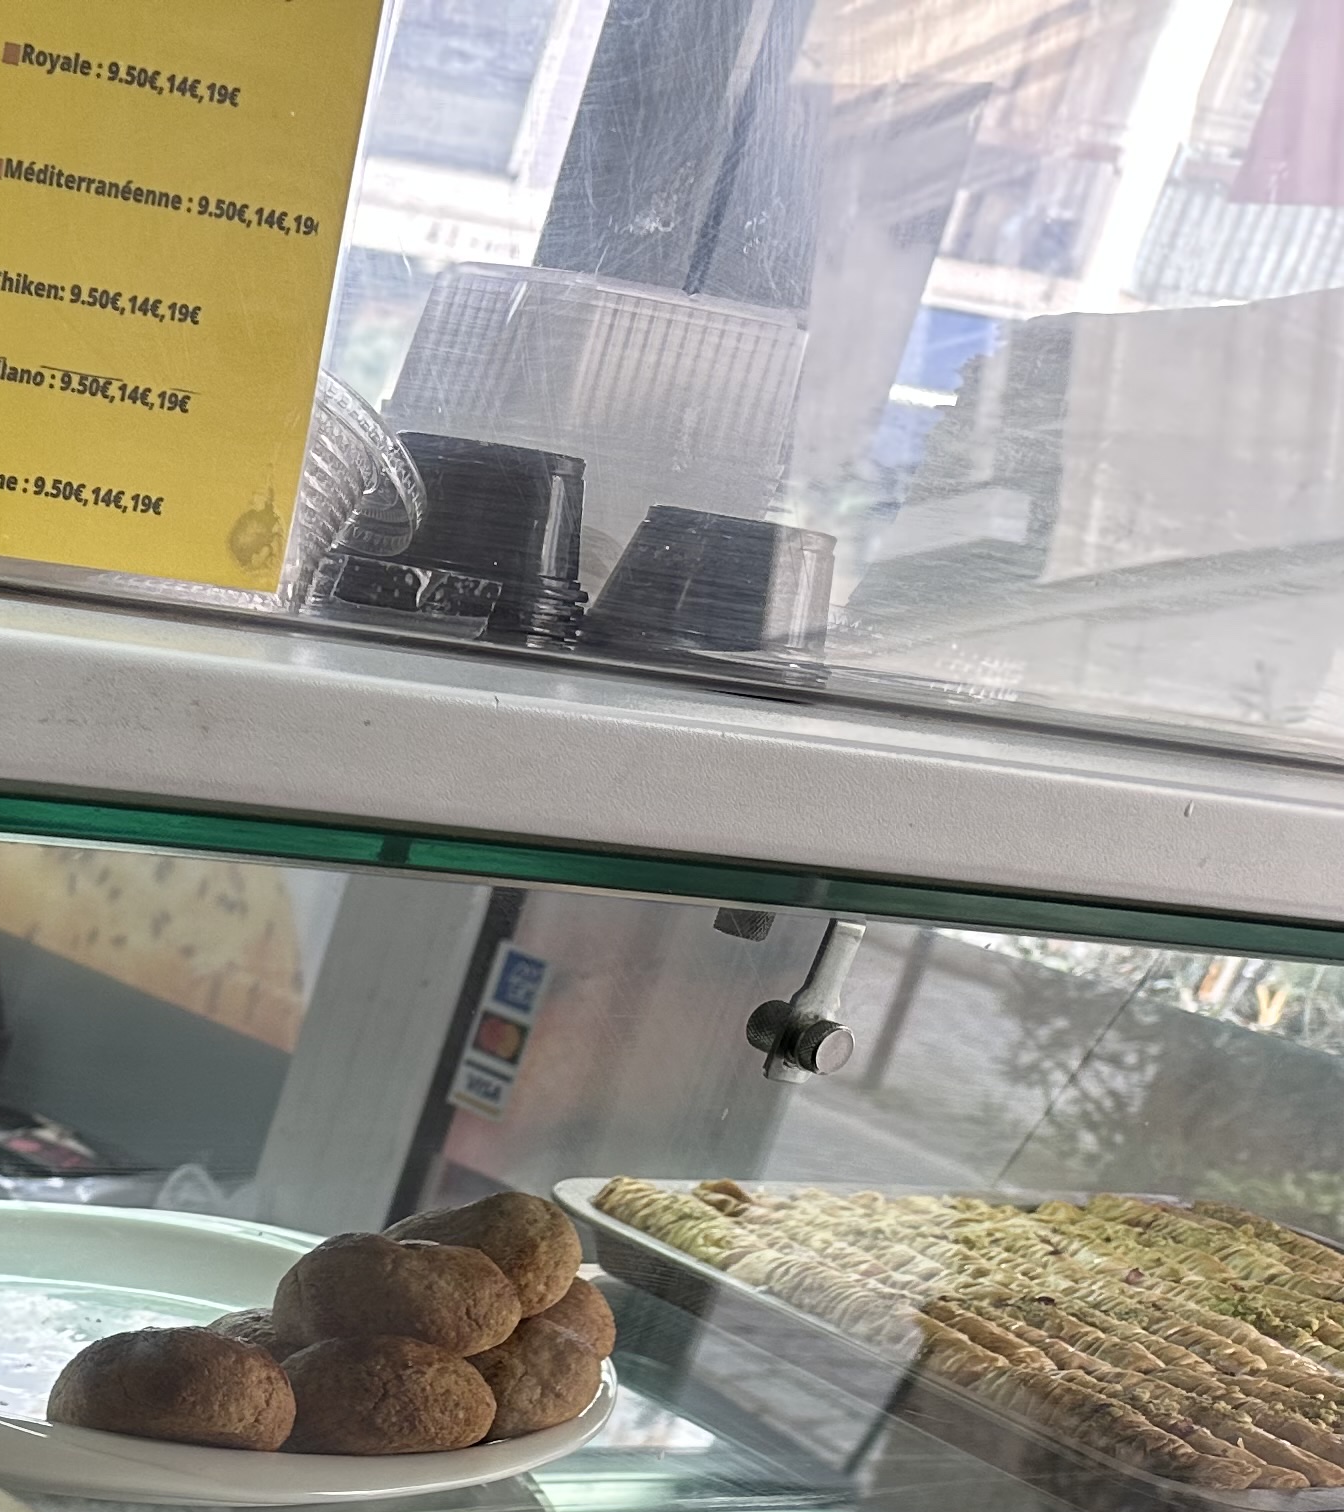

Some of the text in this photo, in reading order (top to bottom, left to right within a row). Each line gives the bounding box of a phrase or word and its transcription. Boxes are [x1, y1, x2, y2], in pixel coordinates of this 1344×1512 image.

[22, 43, 92, 75] Royale
[108, 62, 240, 106] 9.50€,14€,19€
[4, 158, 182, 209] Méditerranéenne
[70, 284, 201, 324] 9.50€,14€,19€
[34, 476, 164, 514] 9.50€,14€,19€
